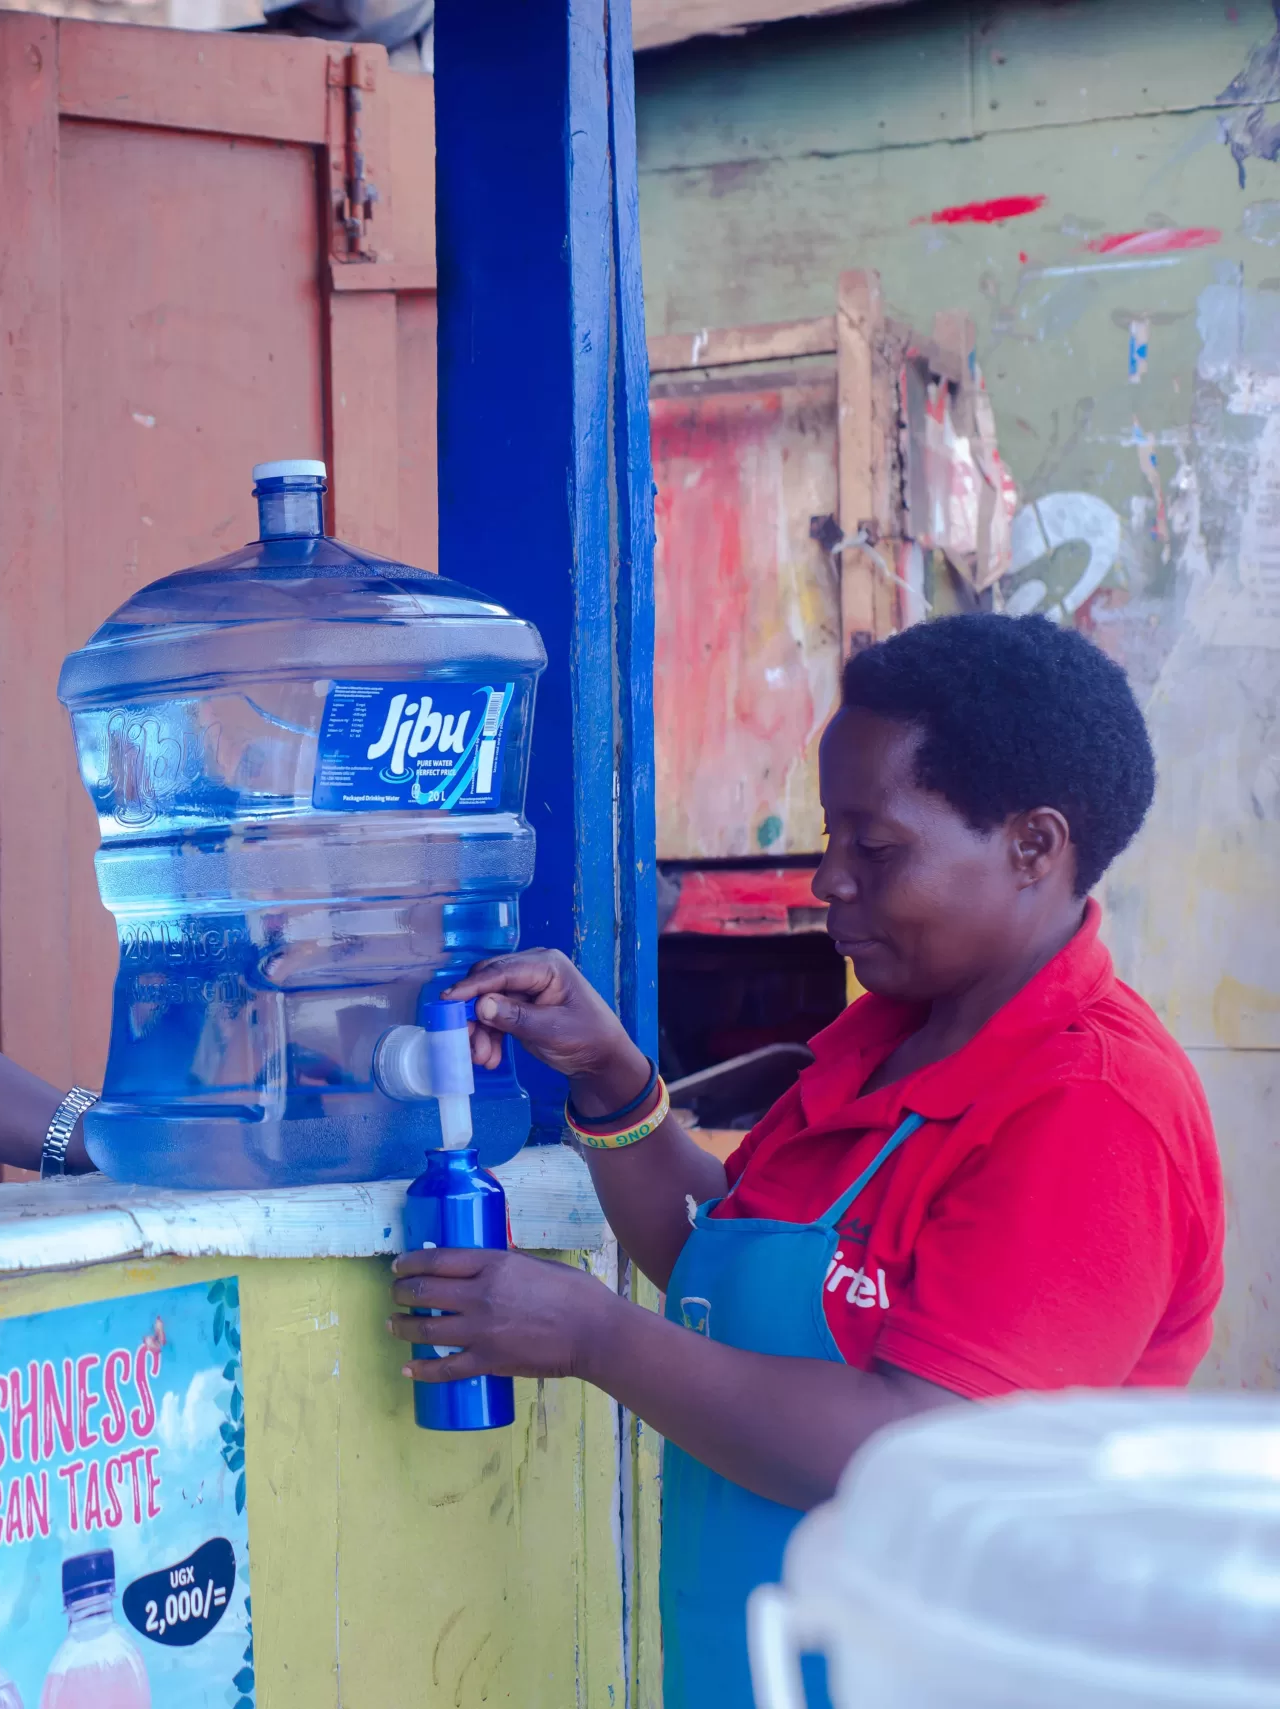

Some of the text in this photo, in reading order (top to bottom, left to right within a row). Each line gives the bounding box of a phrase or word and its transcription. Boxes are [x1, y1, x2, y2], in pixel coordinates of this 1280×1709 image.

[367, 693, 471, 775] Jibu
[343, 795, 365, 803] Packaged
[365, 795, 385, 803] Drinking
[428, 791, 440, 802] 20
[442, 791, 446, 802] L
[121, 922, 155, 961] 20
[587, 1137, 609, 1149] TO
[59, 1447, 161, 1531] TASTE
[169, 1565, 195, 1588] UGX
[145, 1578, 226, 1636] 2,000/=
